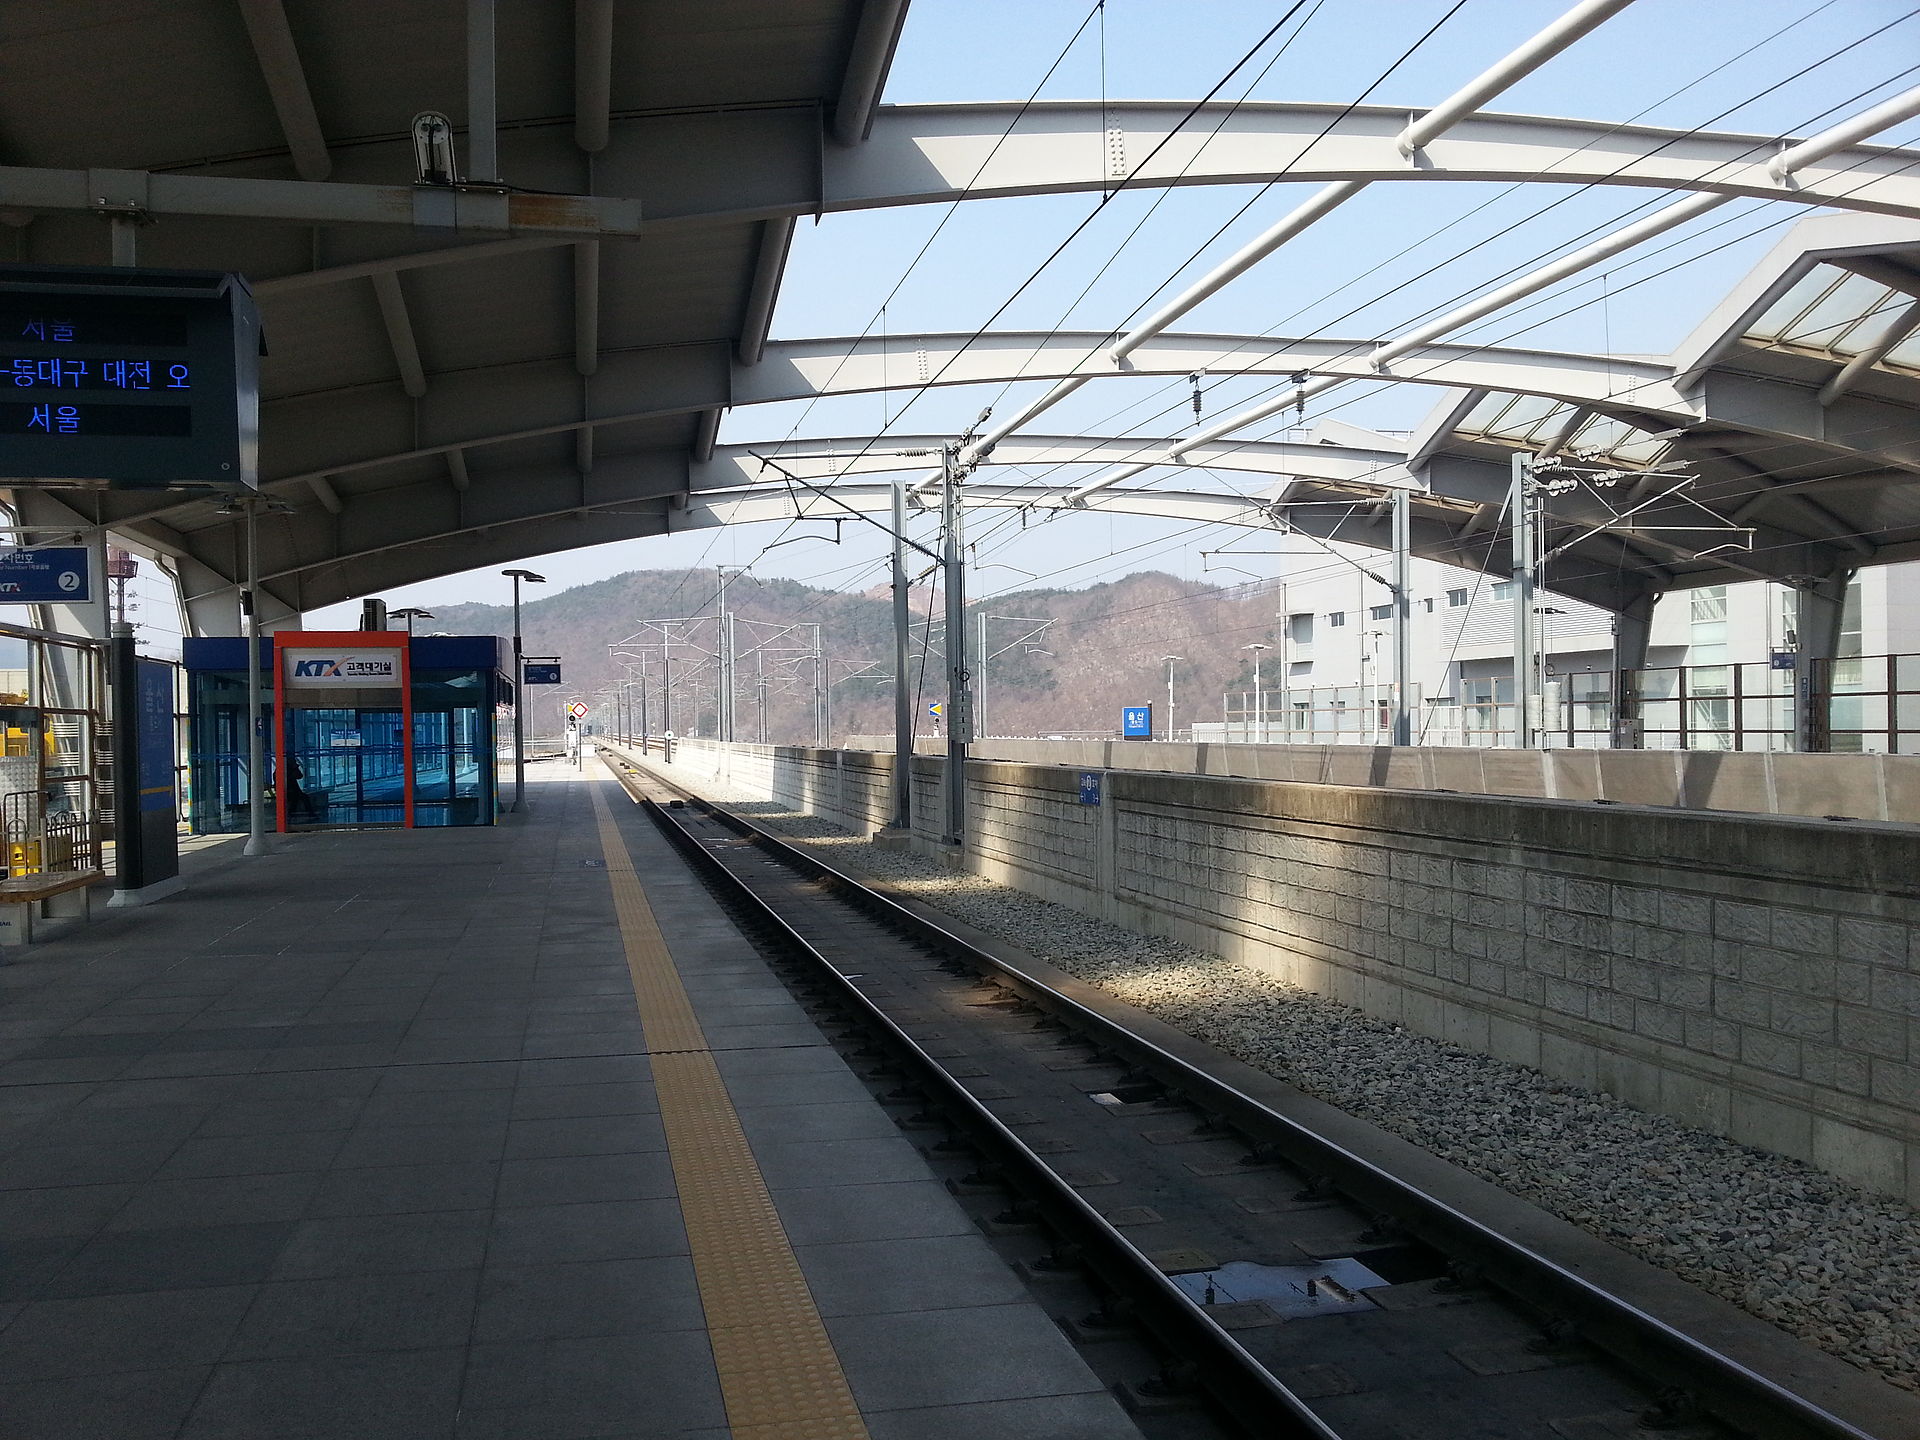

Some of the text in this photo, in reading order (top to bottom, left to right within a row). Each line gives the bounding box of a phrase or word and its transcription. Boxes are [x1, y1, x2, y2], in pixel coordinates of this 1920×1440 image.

[103, 360, 151, 389] 대전
[166, 364, 191, 388] 오
[27, 403, 81, 433] 서울
[64, 574, 75, 588] 2
[295, 658, 392, 677] KTX 고객대기실
